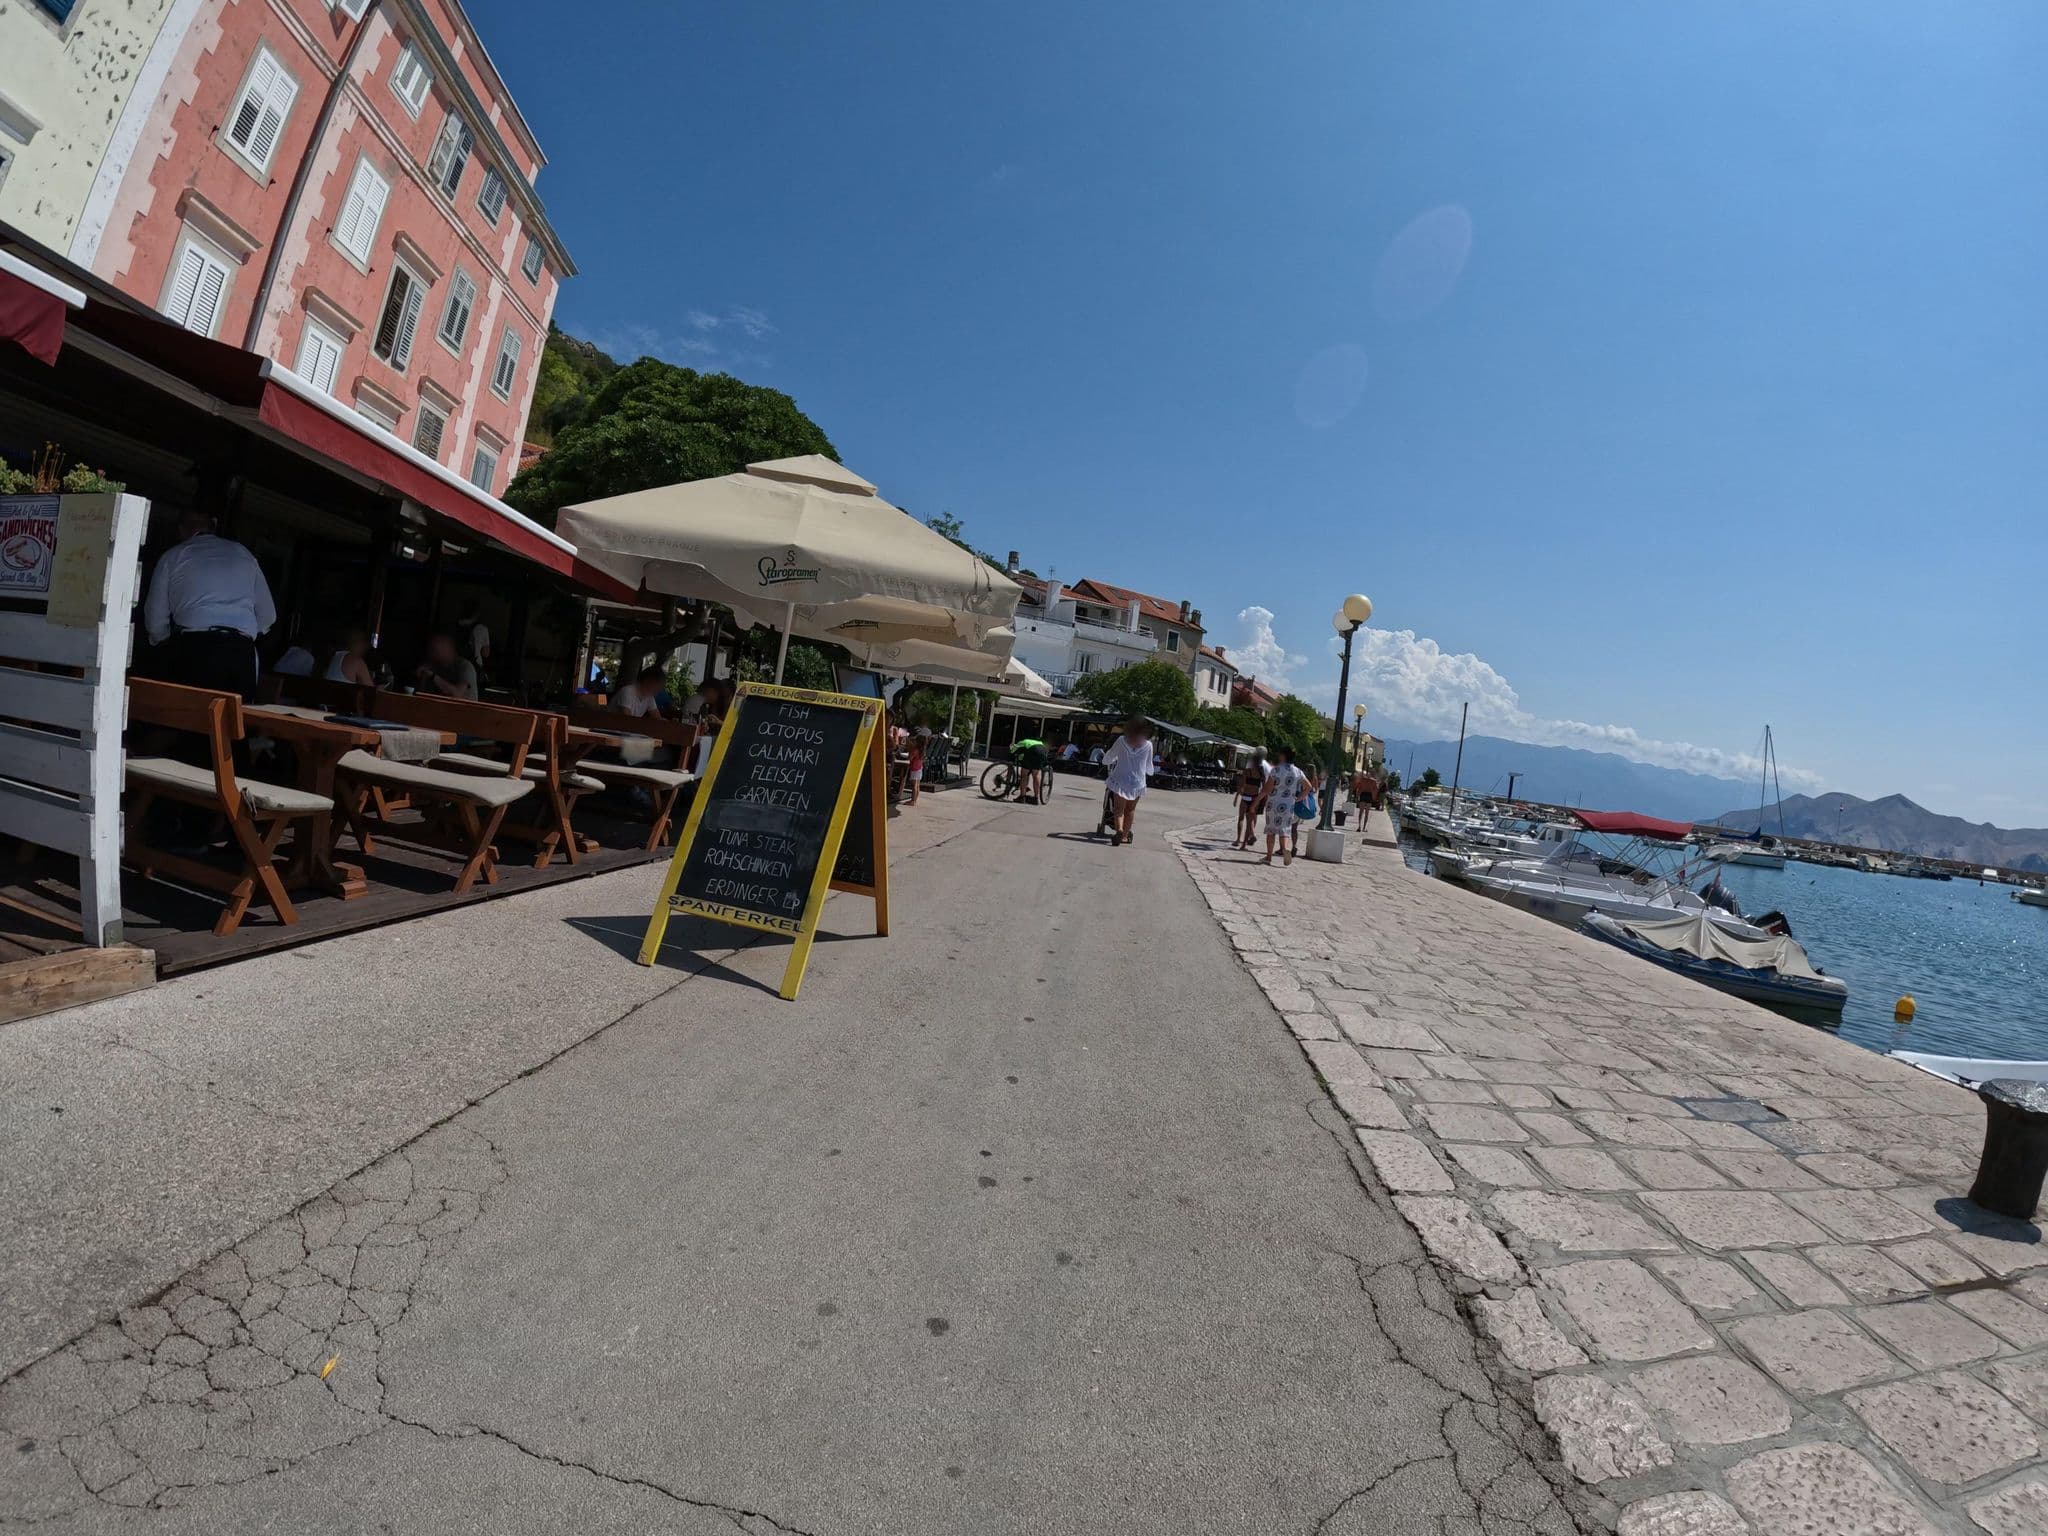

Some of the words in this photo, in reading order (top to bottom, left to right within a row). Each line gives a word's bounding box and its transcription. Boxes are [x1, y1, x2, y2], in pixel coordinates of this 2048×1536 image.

[758, 556, 821, 586] Staropramen
[779, 703, 809, 720] FISH
[758, 721, 824, 744] OCTOPUS
[748, 743, 820, 766] CALAMARI
[750, 764, 807, 786] FLEISCH
[719, 828, 749, 847] TUNA
[753, 834, 797, 857] STEAK
[704, 847, 792, 880] ROHSCHINKEN
[705, 878, 779, 906] ERDINGER
